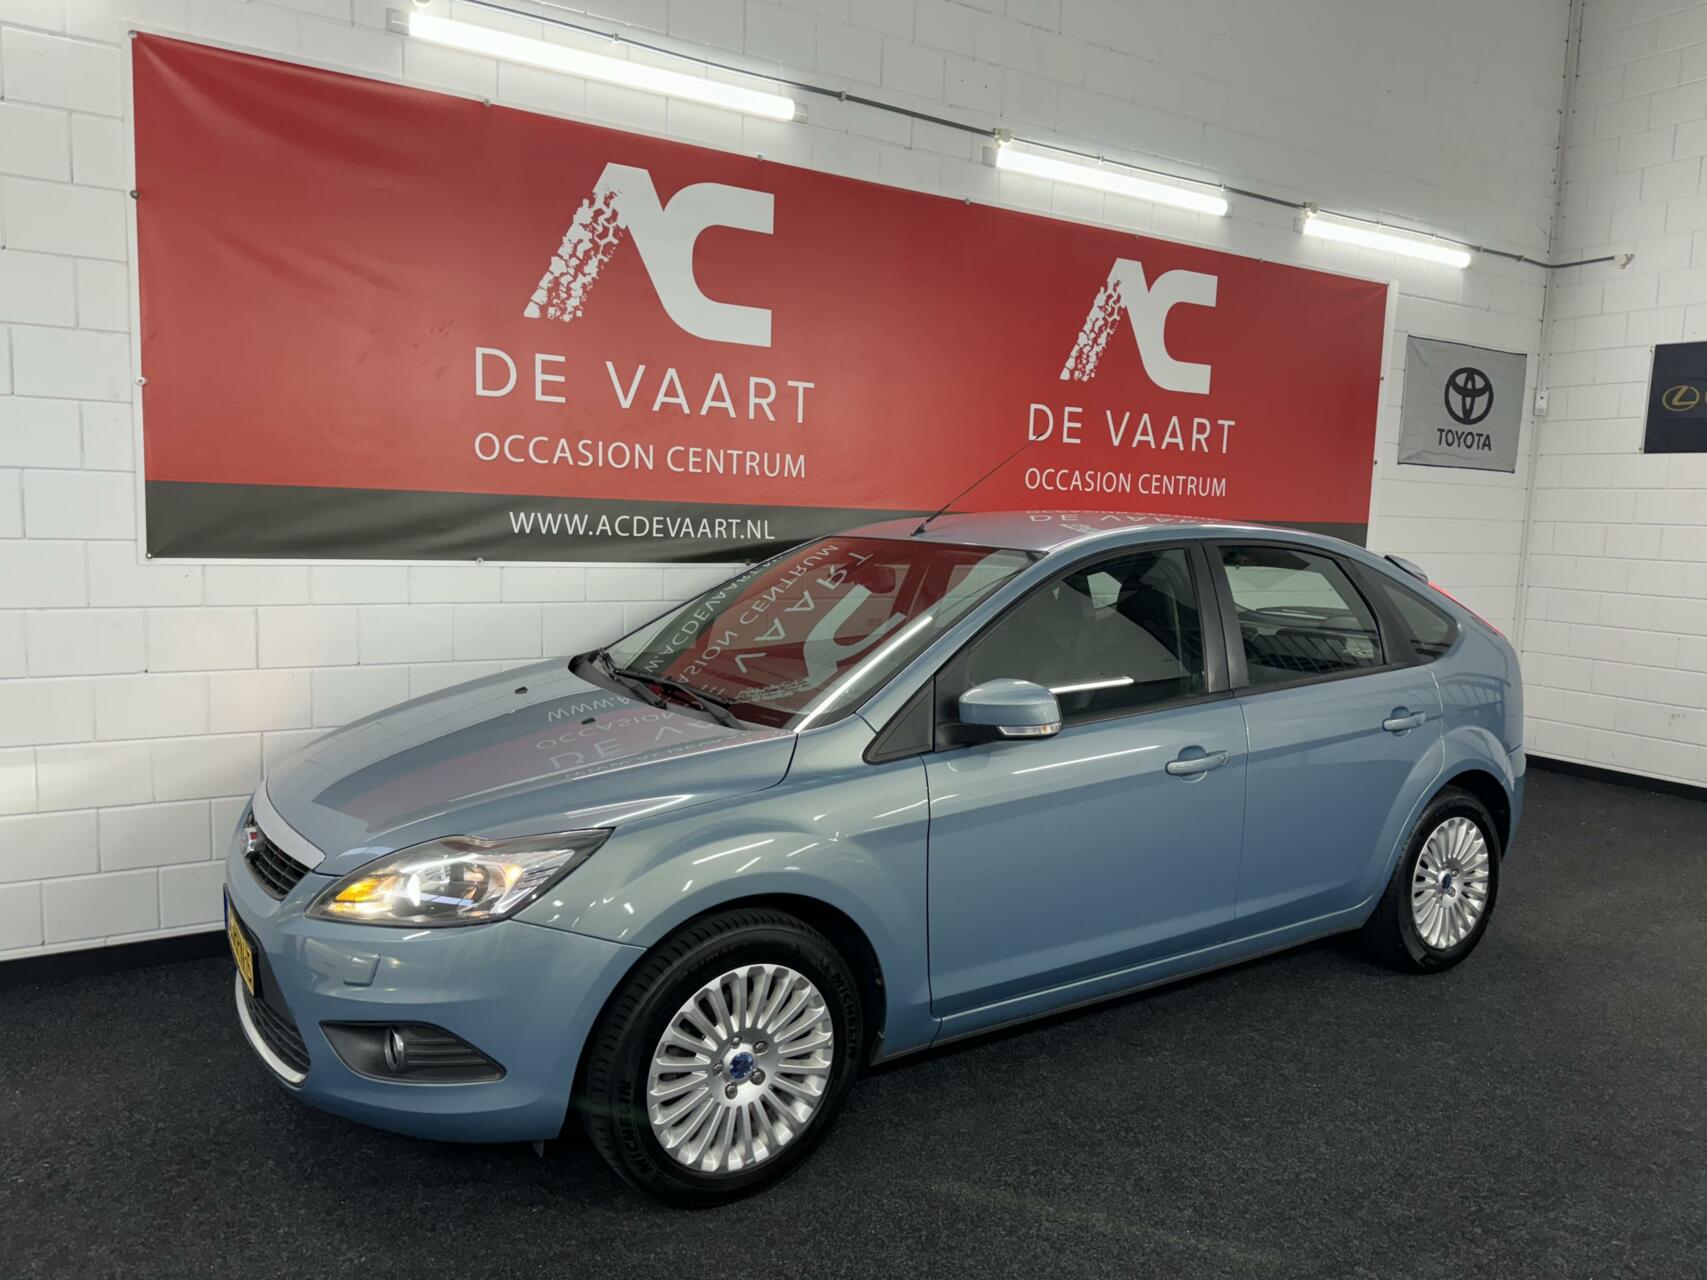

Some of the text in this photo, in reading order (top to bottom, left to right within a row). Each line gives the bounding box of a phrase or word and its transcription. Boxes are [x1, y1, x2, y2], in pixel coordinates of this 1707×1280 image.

[475, 346, 815, 424] DE VAART
[1028, 403, 1236, 454] DE VAART
[1436, 427, 1492, 451] TOYOTA
[474, 432, 806, 479] OCCASION CENTRUM
[1024, 467, 1226, 497] OCCASION CENTRUM
[509, 511, 775, 540] WWW.ACDEVAART.NL
